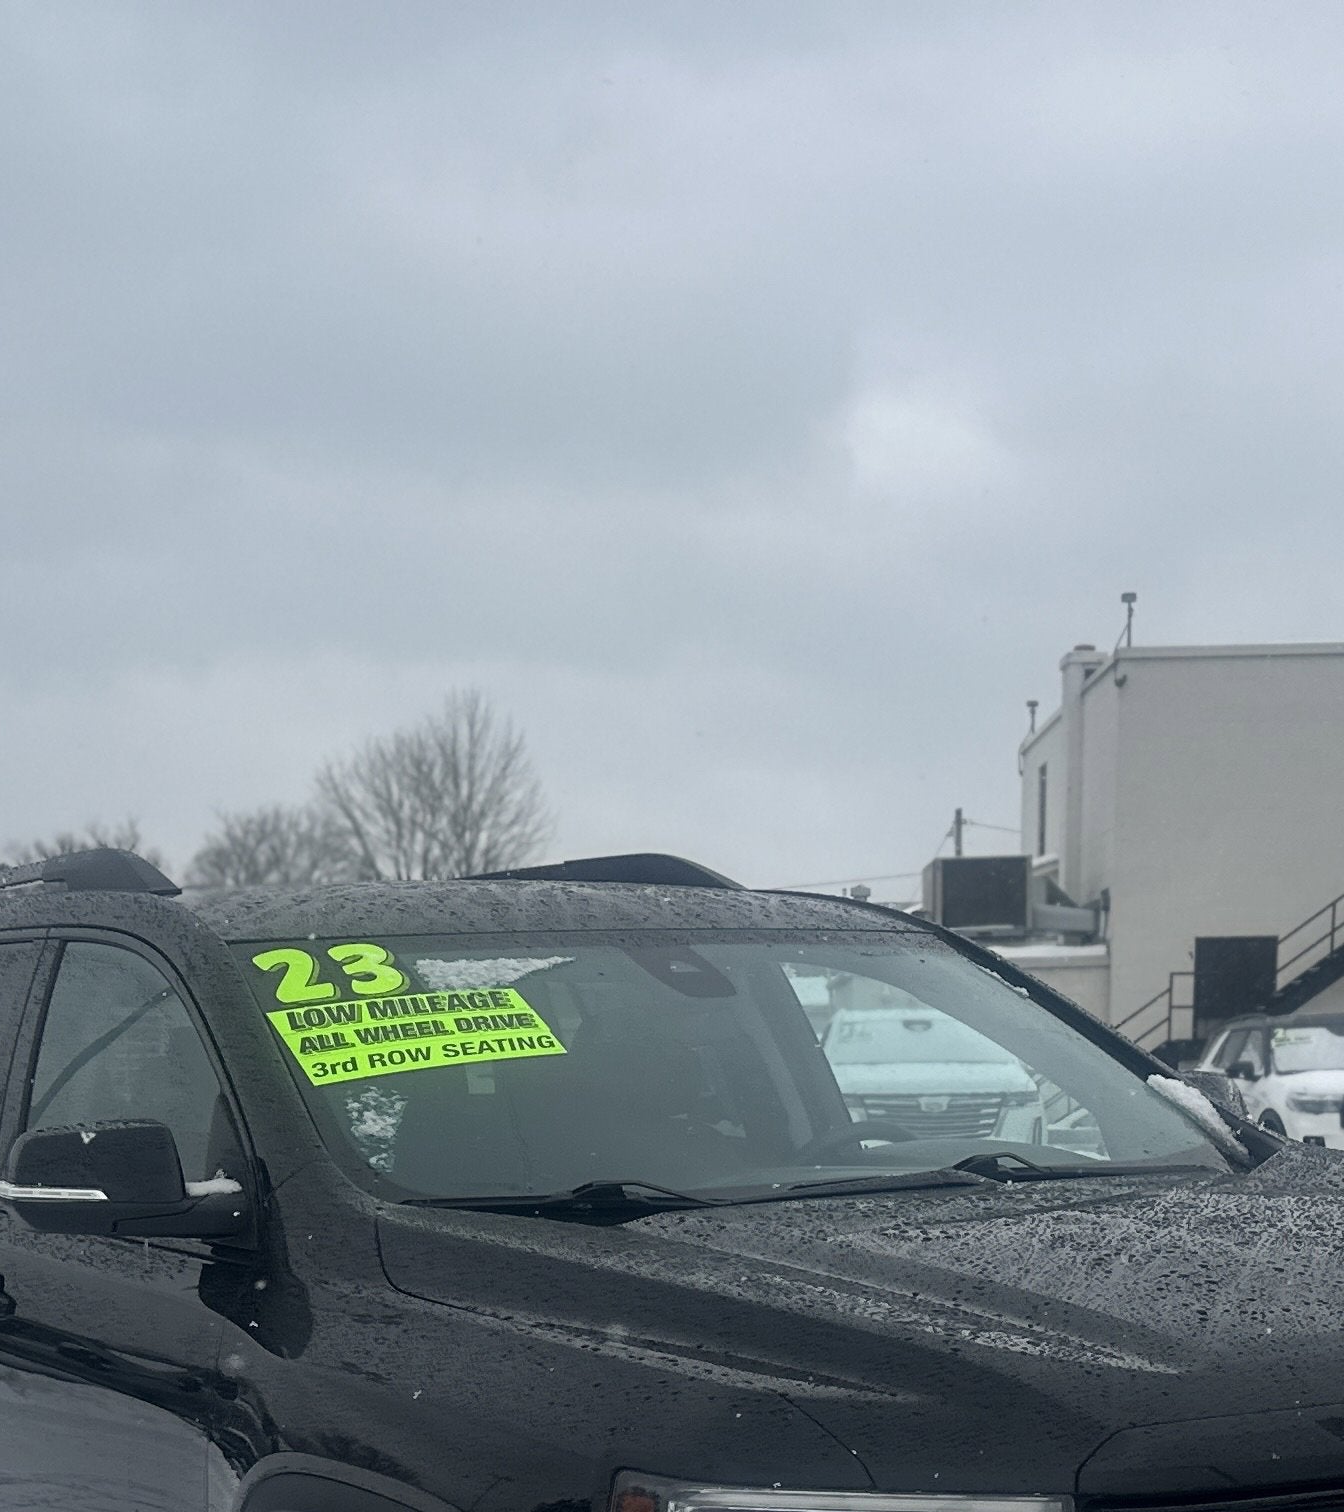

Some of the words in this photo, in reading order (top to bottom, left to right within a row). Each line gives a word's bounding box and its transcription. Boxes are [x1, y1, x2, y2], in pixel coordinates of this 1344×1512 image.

[252, 943, 409, 1004] 23
[287, 1002, 361, 1031] LOW
[366, 989, 512, 1020] MILEAGE
[300, 1032, 354, 1055] ALL
[354, 1021, 454, 1045] WHEEL
[457, 1012, 538, 1033] DRIVE
[312, 1057, 358, 1078] 3rd
[368, 1046, 431, 1069] ROW
[443, 1034, 555, 1058] SEATING
